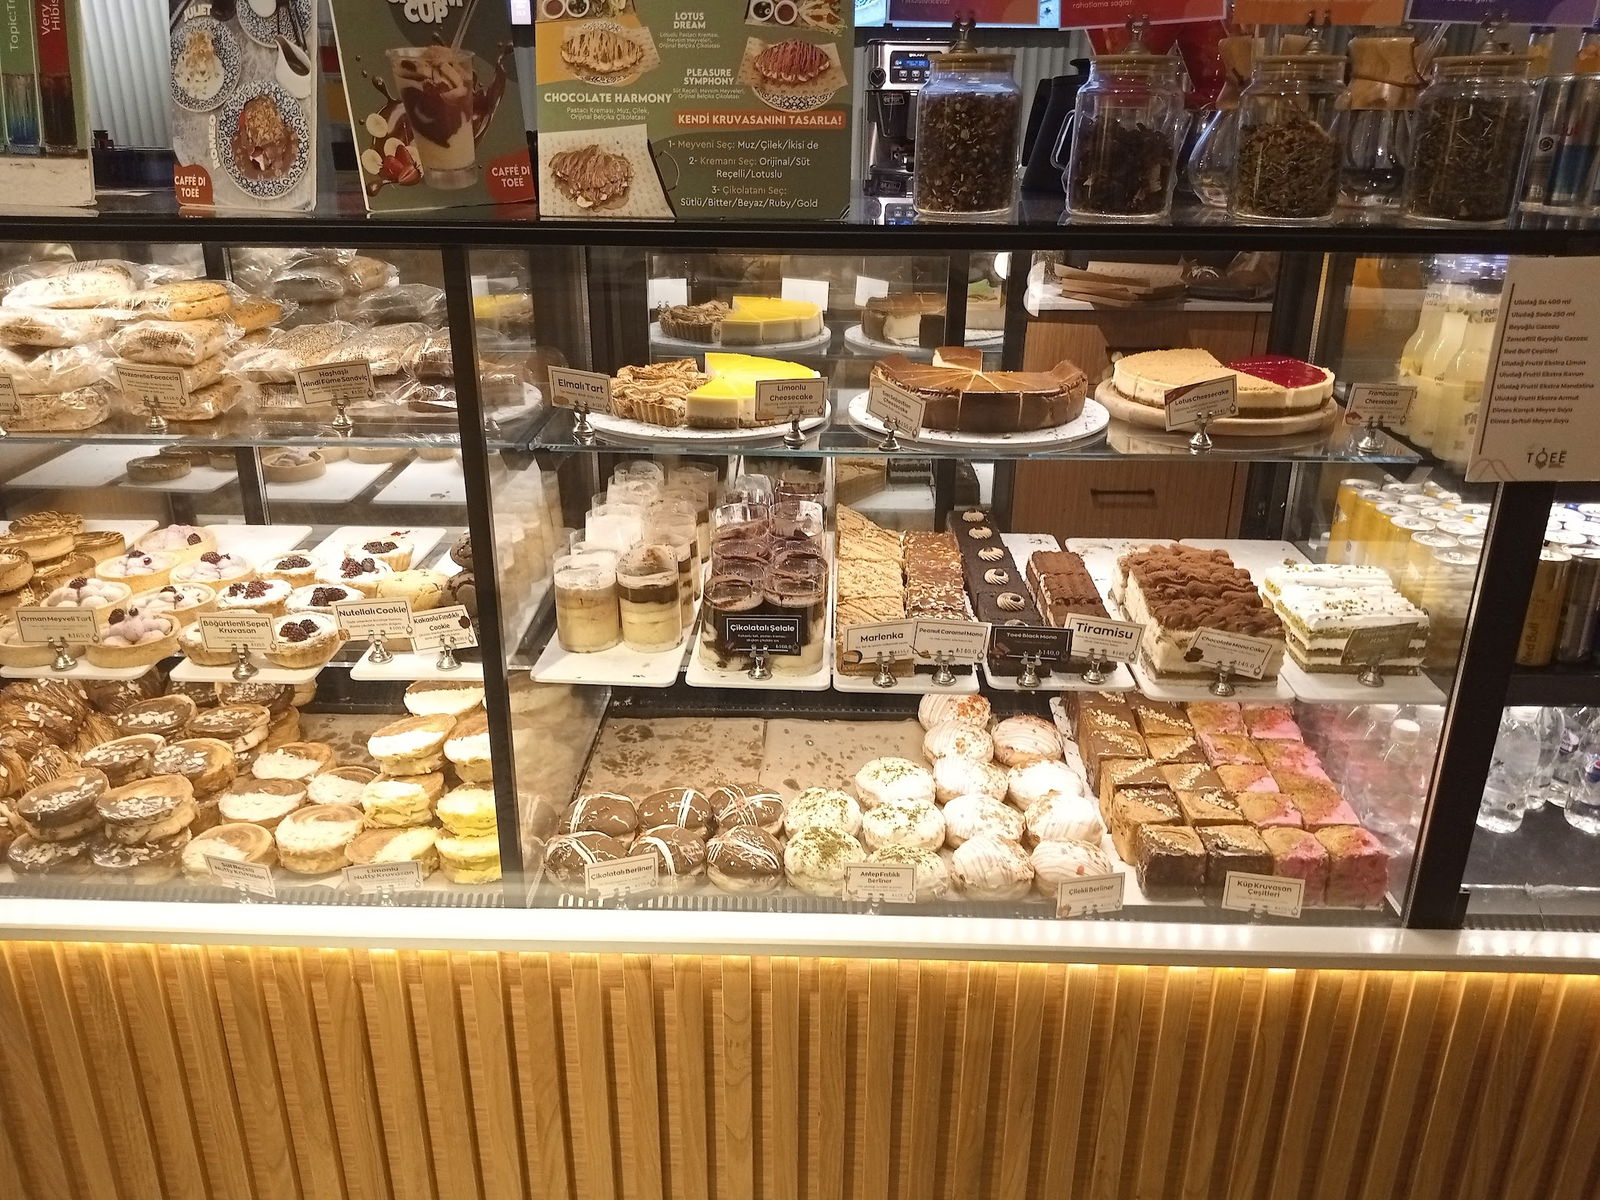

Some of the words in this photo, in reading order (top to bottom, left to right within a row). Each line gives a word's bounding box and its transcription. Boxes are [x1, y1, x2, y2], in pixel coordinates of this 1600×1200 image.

[183, 3, 213, 23] JULIET
[403, 0, 449, 24] CUP
[675, 12, 705, 21] LOTUS
[41, 4, 52, 36] Very
[673, 21, 706, 29] DREAM
[686, 68, 732, 77] PLEASURE
[684, 77, 734, 85] SYMPHONY
[544, 92, 612, 103] CHOCOLATE
[614, 93, 672, 104] HARMONY
[678, 114, 710, 125] KENDİ
[712, 115, 786, 125] KRUVASANINI
[788, 115, 843, 126] TASARLA!
[208, 114, 221, 170] ROMEO
[668, 140, 675, 148] 1-
[677, 140, 714, 151] Meyveni
[716, 140, 736, 151] Seç:
[737, 139, 806, 151] Muz/Çilek/İkisi
[806, 141, 819, 150] de
[688, 157, 697, 165] 2-
[700, 157, 736, 166] Kremanı
[738, 157, 757, 168] Seç:
[759, 157, 811, 167] Orijinal/Süt
[491, 164, 520, 177] CAFFÉ
[521, 166, 530, 176] DI
[716, 169, 783, 180] Reçelli/Lotuslu
[174, 174, 197, 186] CAFFÉ
[198, 176, 206, 187] DI
[501, 175, 525, 188] TOEÉ
[711, 185, 720, 194] 3-
[722, 185, 766, 196] Çikolatanı
[768, 186, 787, 197] Seç:
[680, 197, 819, 209] Sütlü/Bitter/Beyaz/Ruby/Gold
[318, 368, 349, 378] Haşhaşlı
[302, 379, 321, 388] Hindi
[557, 378, 585, 391] Elmalı
[585, 382, 604, 394] Tart
[777, 384, 807, 392] Limonlu
[769, 393, 814, 402] Cheesecake
[1174, 398, 1193, 406] Lotus
[1192, 389, 1229, 402] Cheesecake
[338, 608, 376, 617] Nutellalı
[375, 606, 407, 615] Cookie
[245, 620, 269, 628] Sepet
[413, 615, 439, 624] Kakaolu
[429, 623, 451, 631] Cookie
[730, 624, 770, 632] Çikolatalı
[769, 624, 795, 633] Şelale
[1076, 622, 1134, 640] Tiramisu
[860, 632, 904, 643] Marlenka
[1201, 636, 1232, 646] Chocolate
[233, 869, 266, 880] Kruvasan
[376, 870, 414, 878] Kruvasan
[590, 869, 625, 881] Çikolatalı
[625, 865, 653, 874] Berliner
[1068, 887, 1089, 896] Çilekli
[1088, 884, 1114, 893] Berliner
[1236, 880, 1254, 889] Küp
[1253, 882, 1292, 893] Kruvasan
[1247, 888, 1280, 898] Çeşitleri
